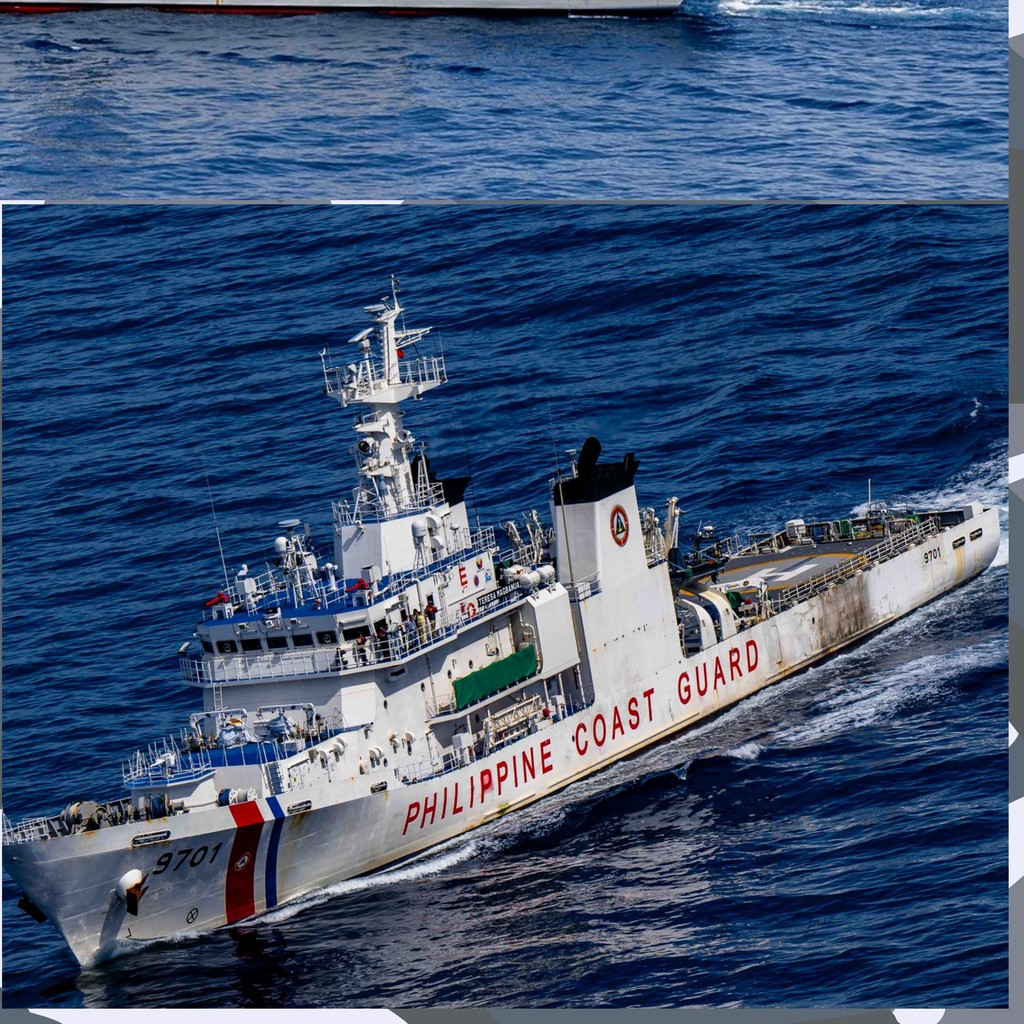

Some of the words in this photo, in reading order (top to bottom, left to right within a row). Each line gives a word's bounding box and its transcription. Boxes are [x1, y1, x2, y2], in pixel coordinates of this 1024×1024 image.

[923, 546, 941, 564] 9701
[479, 592, 496, 605] TERESA
[402, 738, 553, 836] PHILIPPINE
[575, 687, 655, 756] COAST
[677, 639, 759, 705] GUARD
[152, 841, 224, 875] 9701
